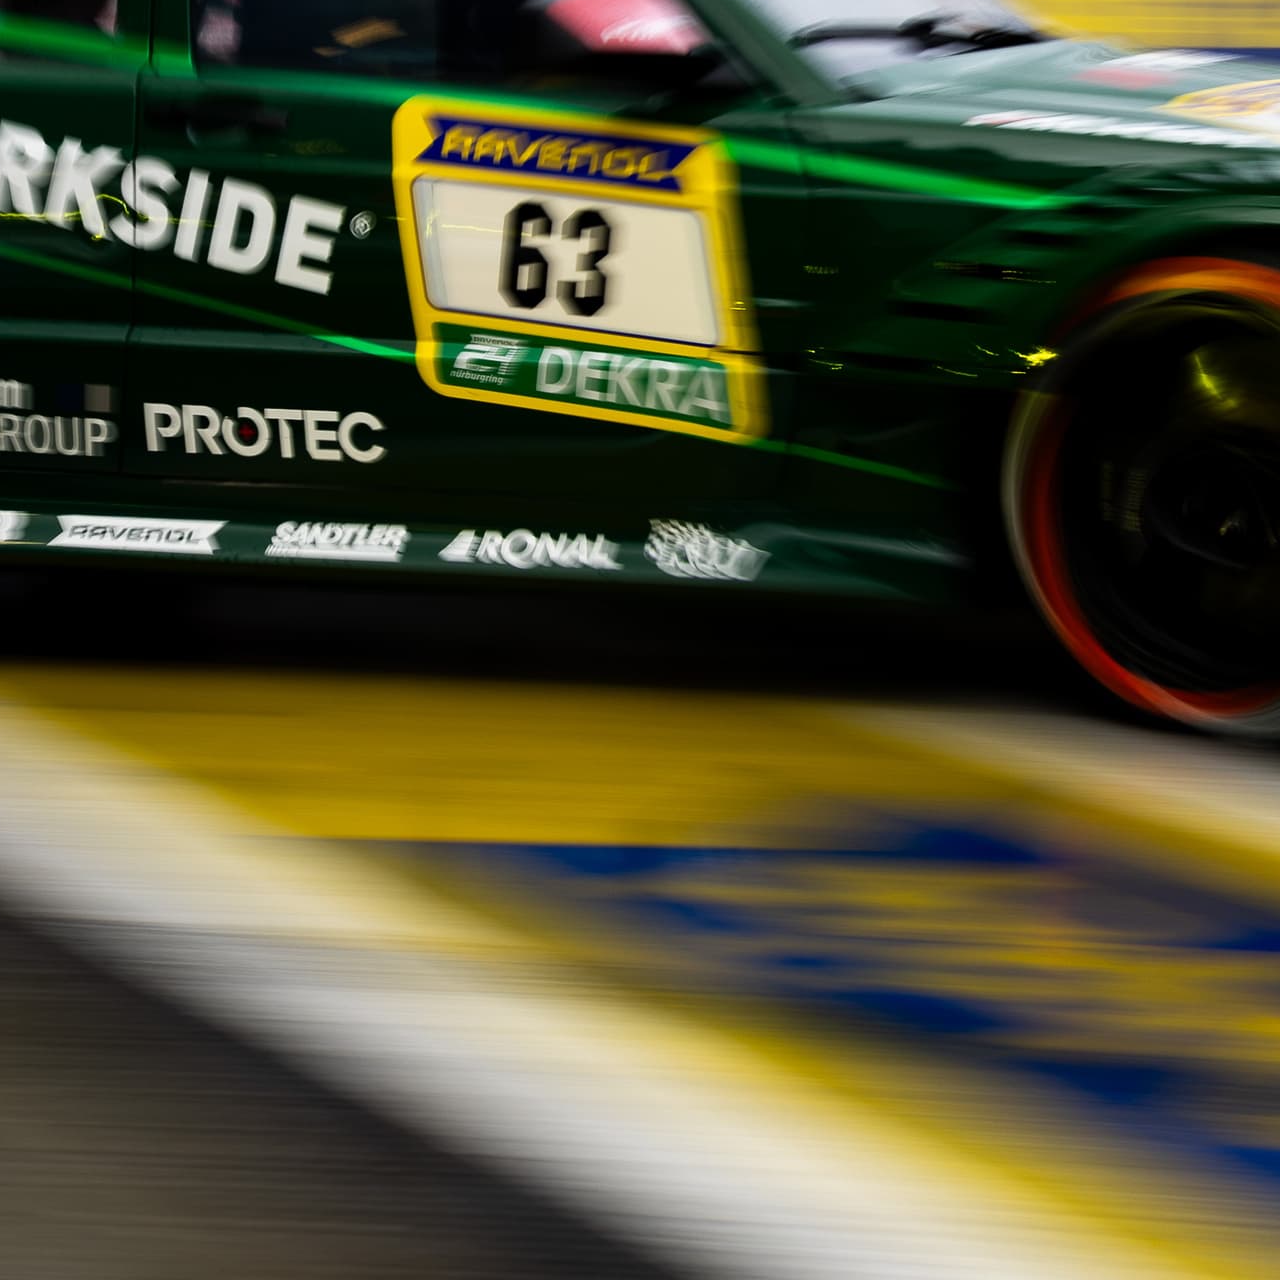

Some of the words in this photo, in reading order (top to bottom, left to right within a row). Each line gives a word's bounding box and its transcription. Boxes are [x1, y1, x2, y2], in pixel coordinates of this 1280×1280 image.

[440, 125, 672, 181] RAVENOL
[498, 202, 611, 317] 63
[535, 346, 731, 424] DEKRA
[143, 403, 387, 462] PROTEC
[67, 523, 203, 545] RAVENOL
[271, 521, 411, 548] SANDTLER
[477, 528, 624, 570] RONAL
